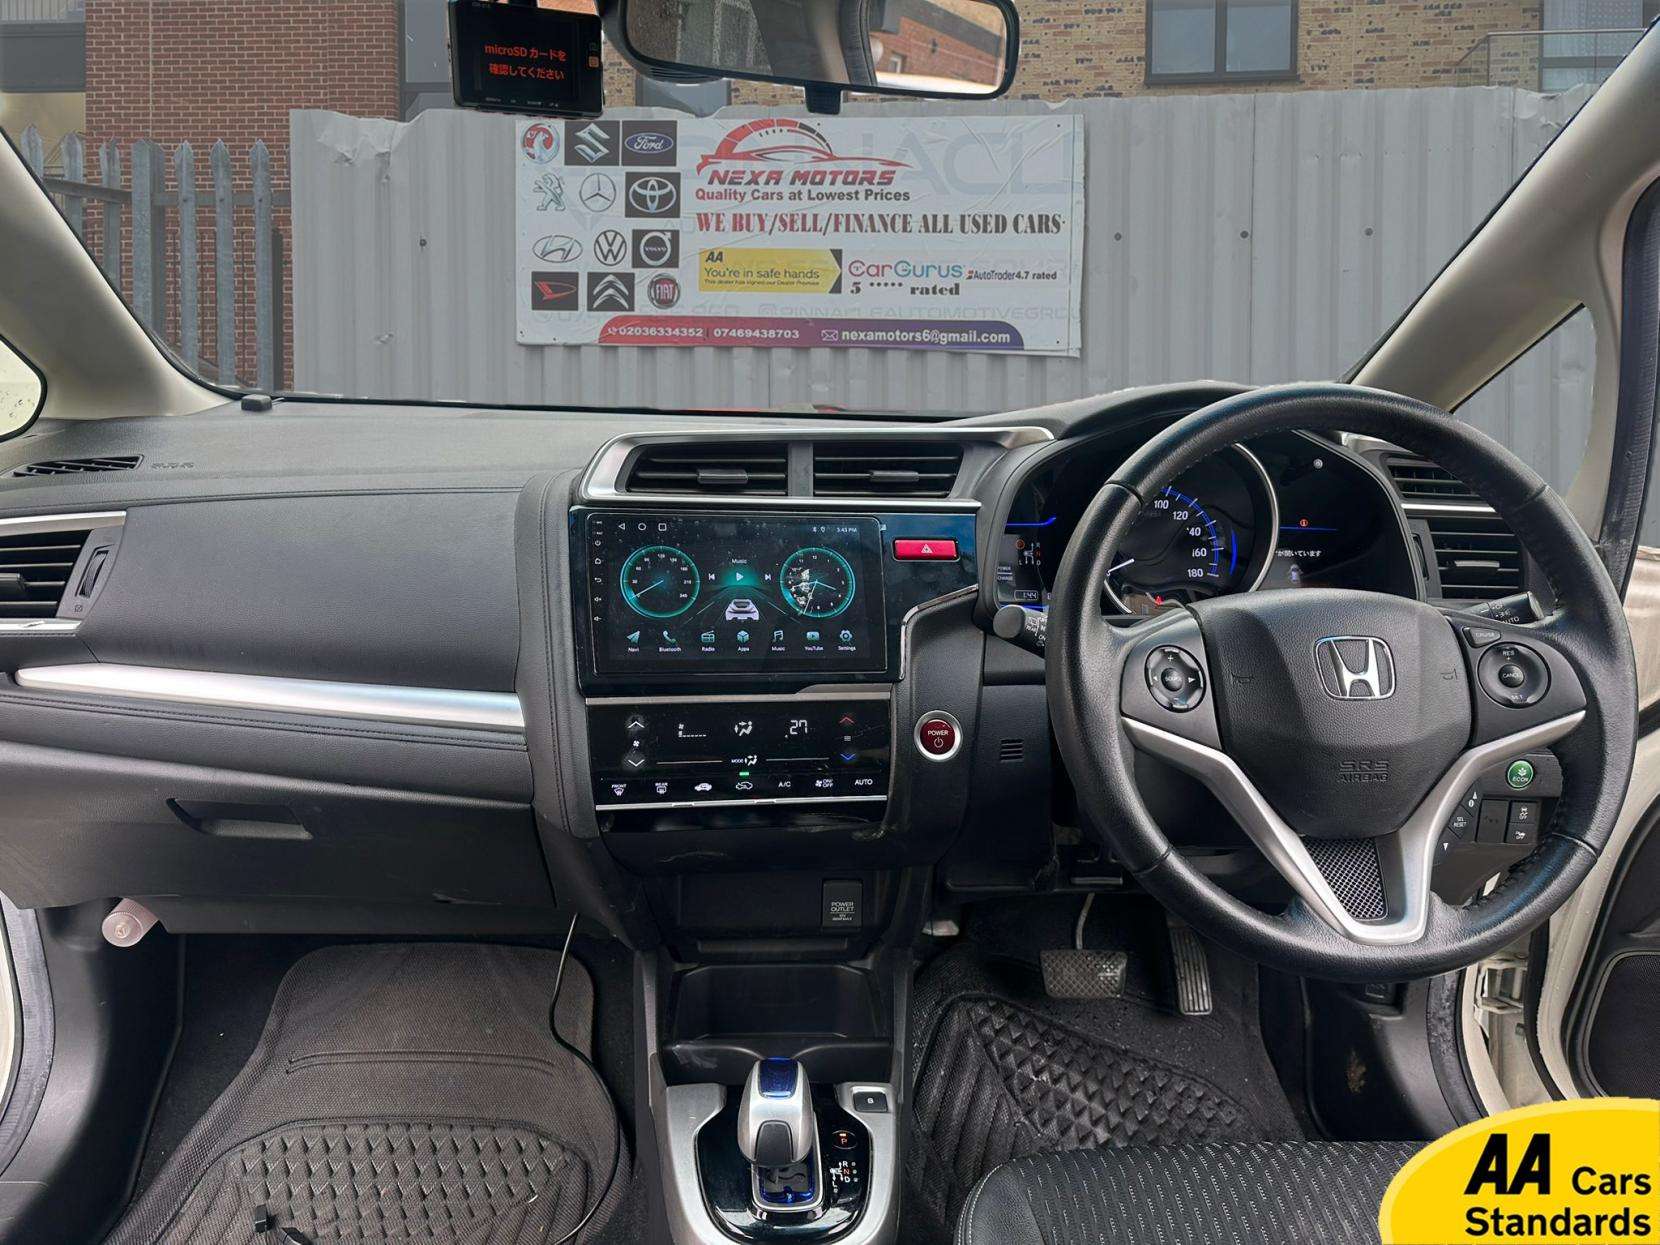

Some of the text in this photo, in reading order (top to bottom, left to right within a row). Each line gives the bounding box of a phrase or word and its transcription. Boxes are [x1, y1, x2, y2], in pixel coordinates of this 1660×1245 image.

[484, 44, 567, 62] microSD カードを
[489, 63, 567, 80] 確認してください
[634, 135, 664, 151] Ford
[707, 170, 896, 186] NEXA MOTORS
[695, 188, 910, 203] Quality Cars at Lowest Prices
[696, 212, 725, 233] WE
[732, 212, 913, 236] BUY/SELL/FINANCE
[918, 213, 953, 234] ALL
[960, 213, 1008, 234] USED
[1012, 213, 1062, 234] CARS
[705, 251, 724, 263] AA
[704, 267, 820, 279] You're in safe hands
[848, 260, 964, 278] CarGurus
[1031, 271, 1057, 281] rated
[655, 283, 674, 301] FIAT
[850, 281, 960, 296] 5 rated
[618, 327, 801, 340] 02036334352 07469438703
[842, 329, 1011, 346] nexamotors6@gmail.com
[1153, 499, 1170, 510] 100
[1172, 510, 1189, 520] 120
[1187, 568, 1204, 578] 180
[789, 719, 808, 735] 27
[1339, 760, 1390, 771] SRS
[1336, 772, 1391, 783] AIRBAG
